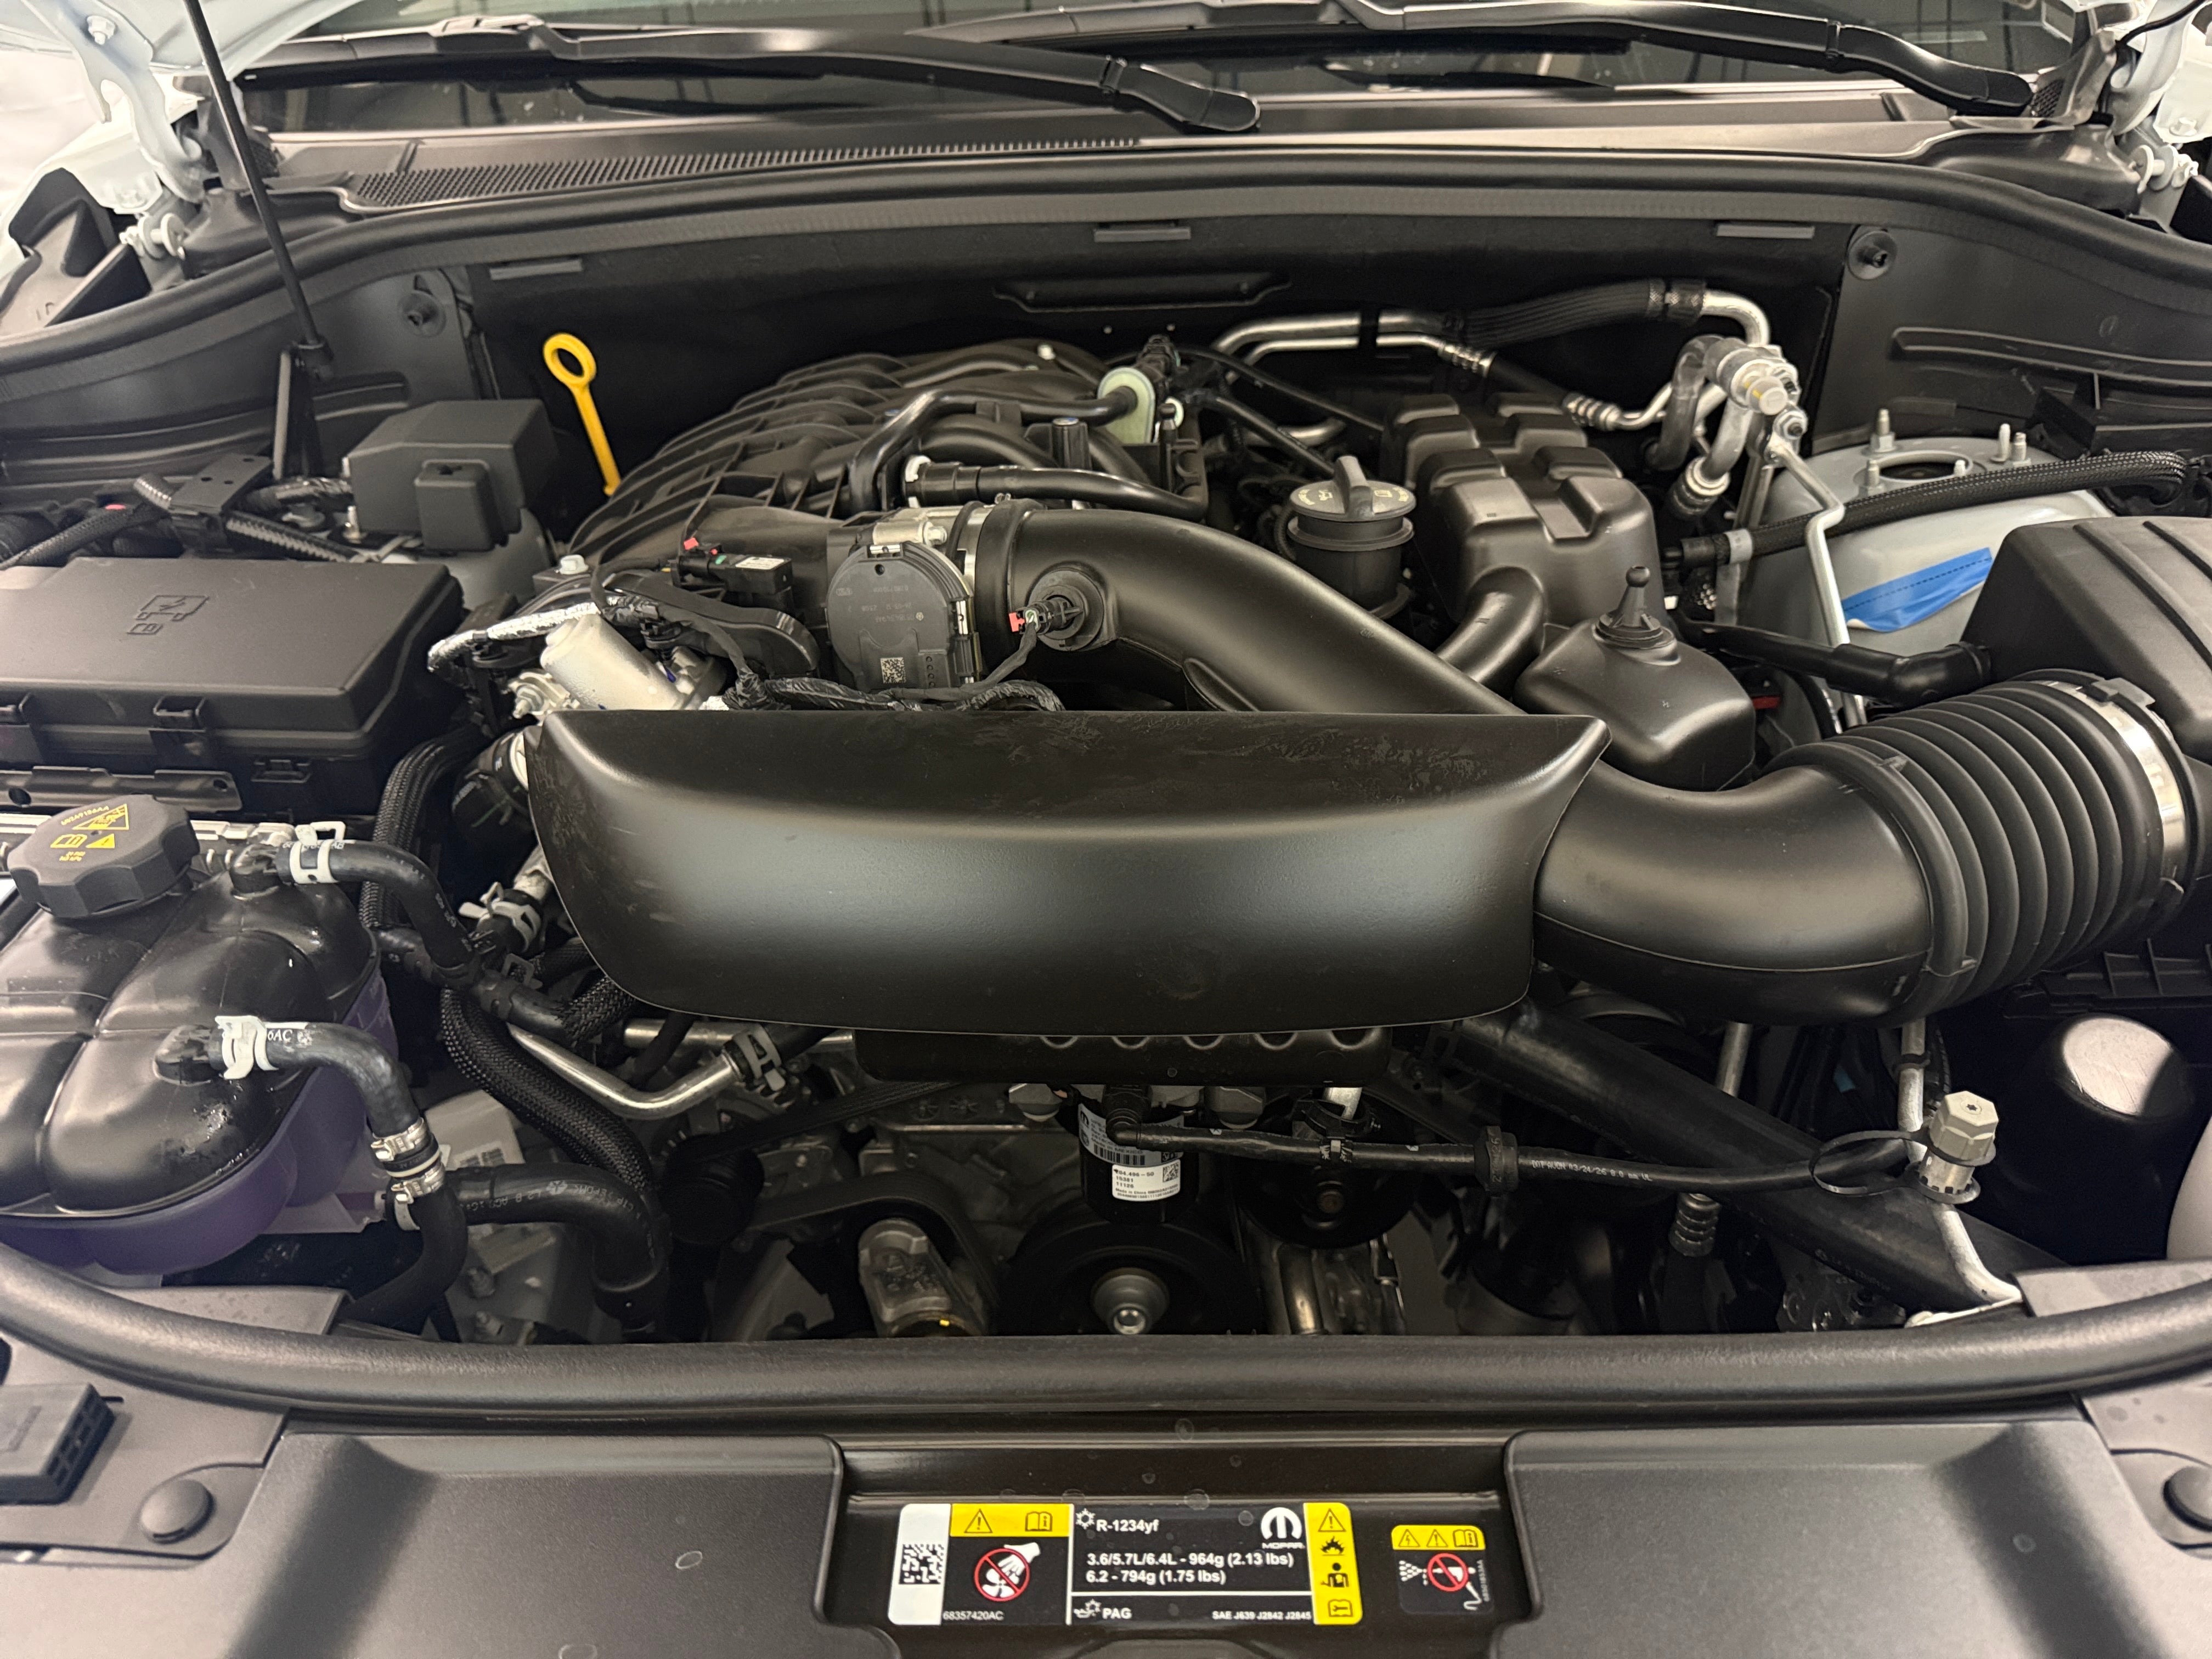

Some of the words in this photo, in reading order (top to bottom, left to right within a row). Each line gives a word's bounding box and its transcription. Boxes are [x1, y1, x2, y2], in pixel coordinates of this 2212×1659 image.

[1096, 1519, 1160, 1534] R-1234yf
[1087, 1553, 1178, 1566] 3.6/5.7L/6.4L
[1188, 1553, 1224, 1568] 964g
[1227, 1553, 1263, 1568] (2.13
[1265, 1553, 1295, 1568] lbs)
[1086, 1570, 1109, 1583] 6.2
[1120, 1570, 1156, 1585] 794g
[1159, 1570, 1195, 1585] (1.75
[1198, 1570, 1227, 1585] lbs)
[943, 1611, 1004, 1620] 68357420AC
[1102, 1607, 1132, 1619] PAG
[1212, 1611, 1233, 1620] SAE
[1233, 1611, 1256, 1620] J639
[1256, 1611, 1284, 1620] J2842
[1285, 1611, 1312, 1620] J2845
